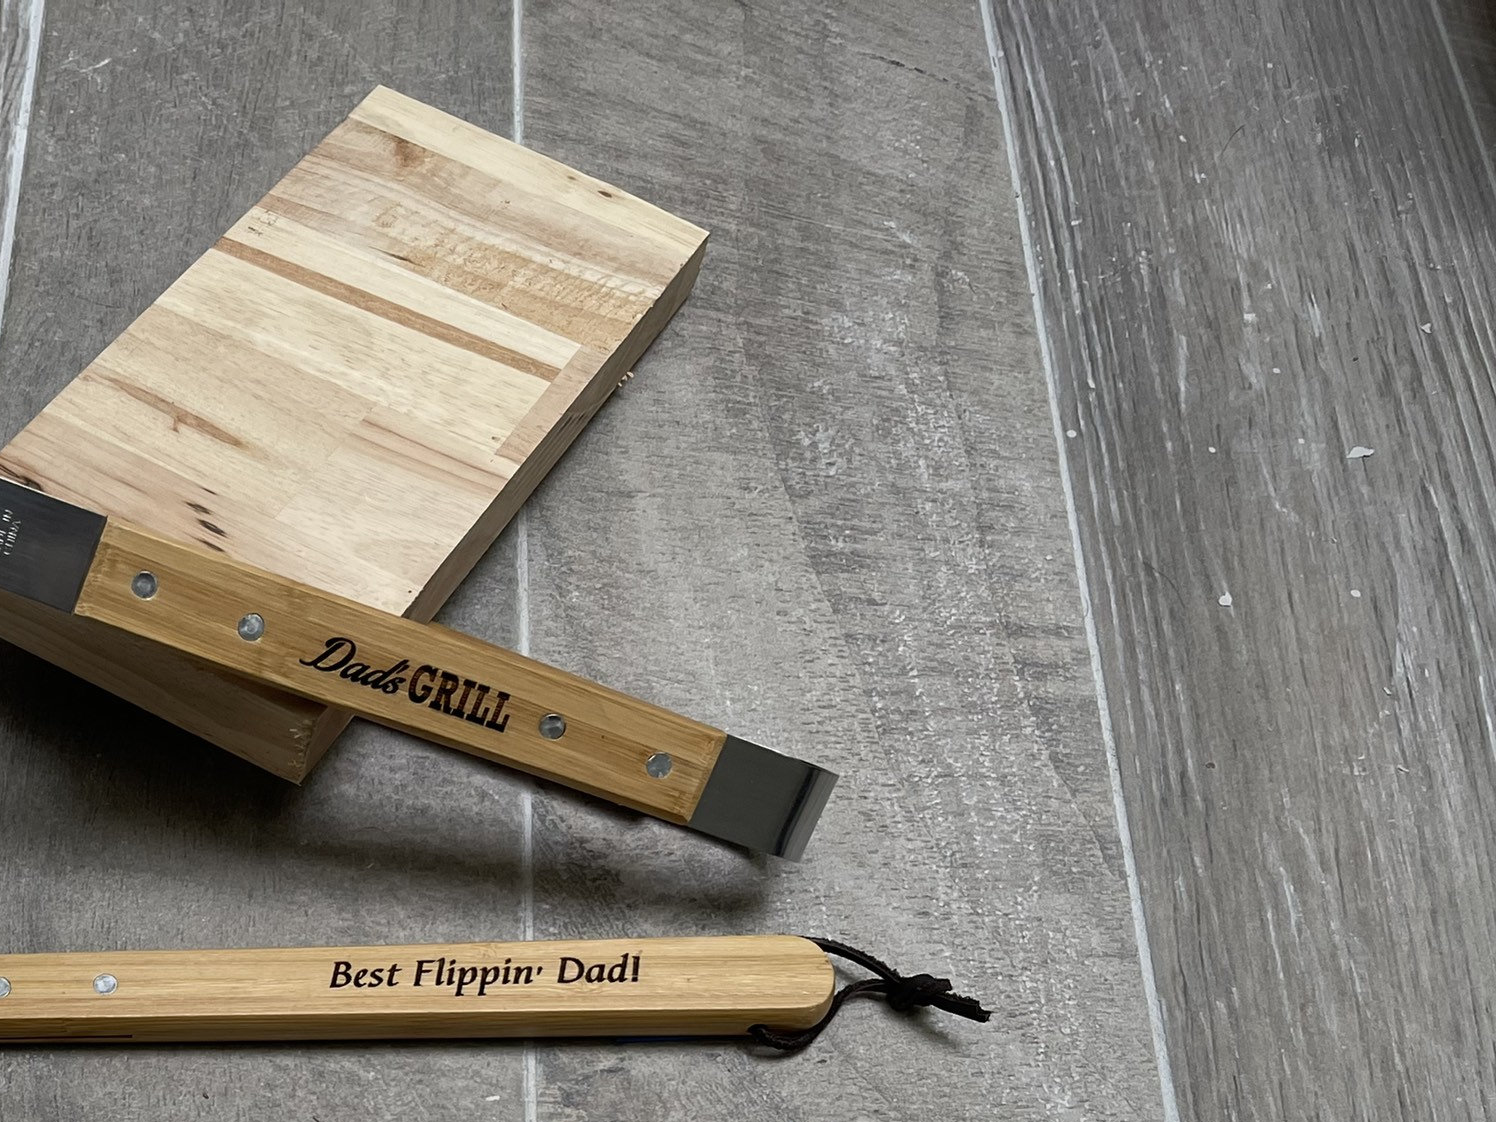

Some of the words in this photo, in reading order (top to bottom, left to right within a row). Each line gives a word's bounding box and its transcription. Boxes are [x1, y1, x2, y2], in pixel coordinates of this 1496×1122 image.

[408, 664, 512, 733] GRILL
[330, 959, 402, 989] Best
[413, 957, 543, 997] Flippin'
[557, 952, 641, 984] Dad!
